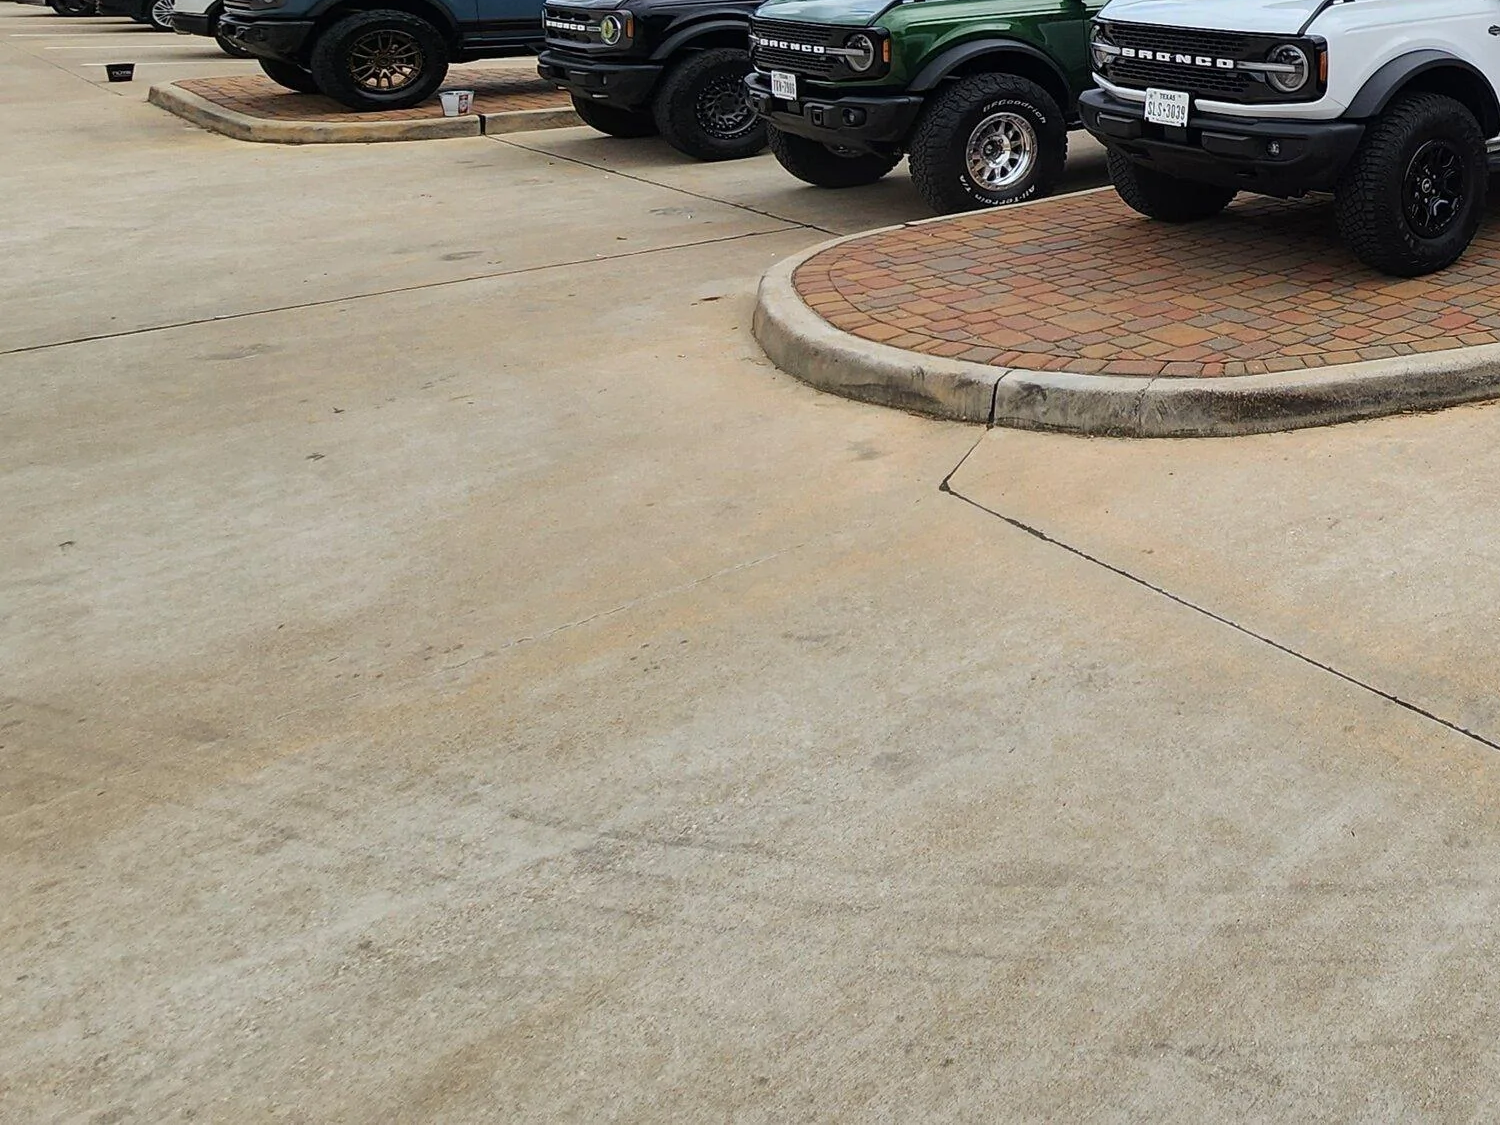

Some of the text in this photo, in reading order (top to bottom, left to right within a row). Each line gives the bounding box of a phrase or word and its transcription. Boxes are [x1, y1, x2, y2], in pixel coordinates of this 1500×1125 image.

[760, 38, 825, 54] BRONCO
[1121, 47, 1235, 70] BRONCO
[1160, 92, 1176, 102] TEXAS
